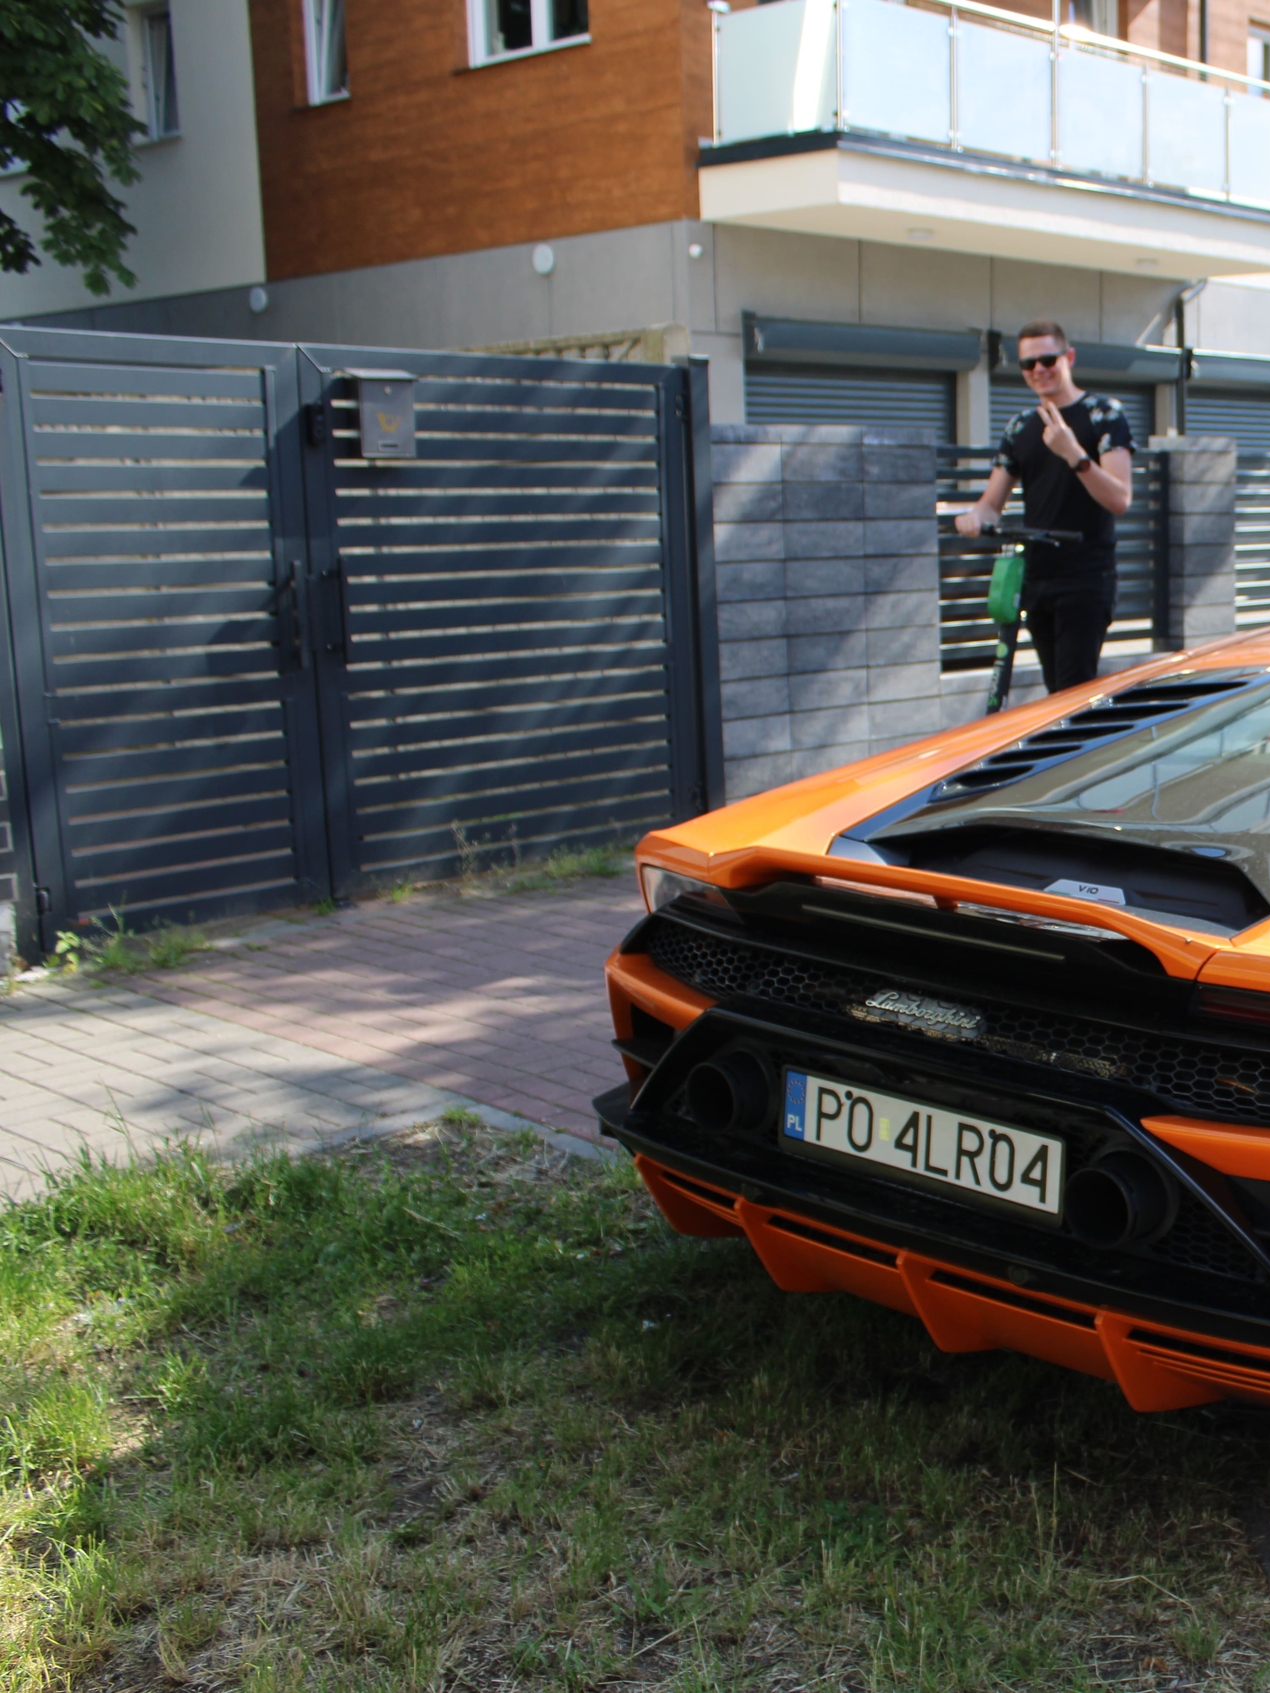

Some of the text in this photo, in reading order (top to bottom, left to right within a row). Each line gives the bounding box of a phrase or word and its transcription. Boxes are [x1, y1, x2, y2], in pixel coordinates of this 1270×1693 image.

[1078, 884, 1099, 895] V10
[865, 991, 981, 1029] Lamborghini
[787, 1114, 802, 1132] PL
